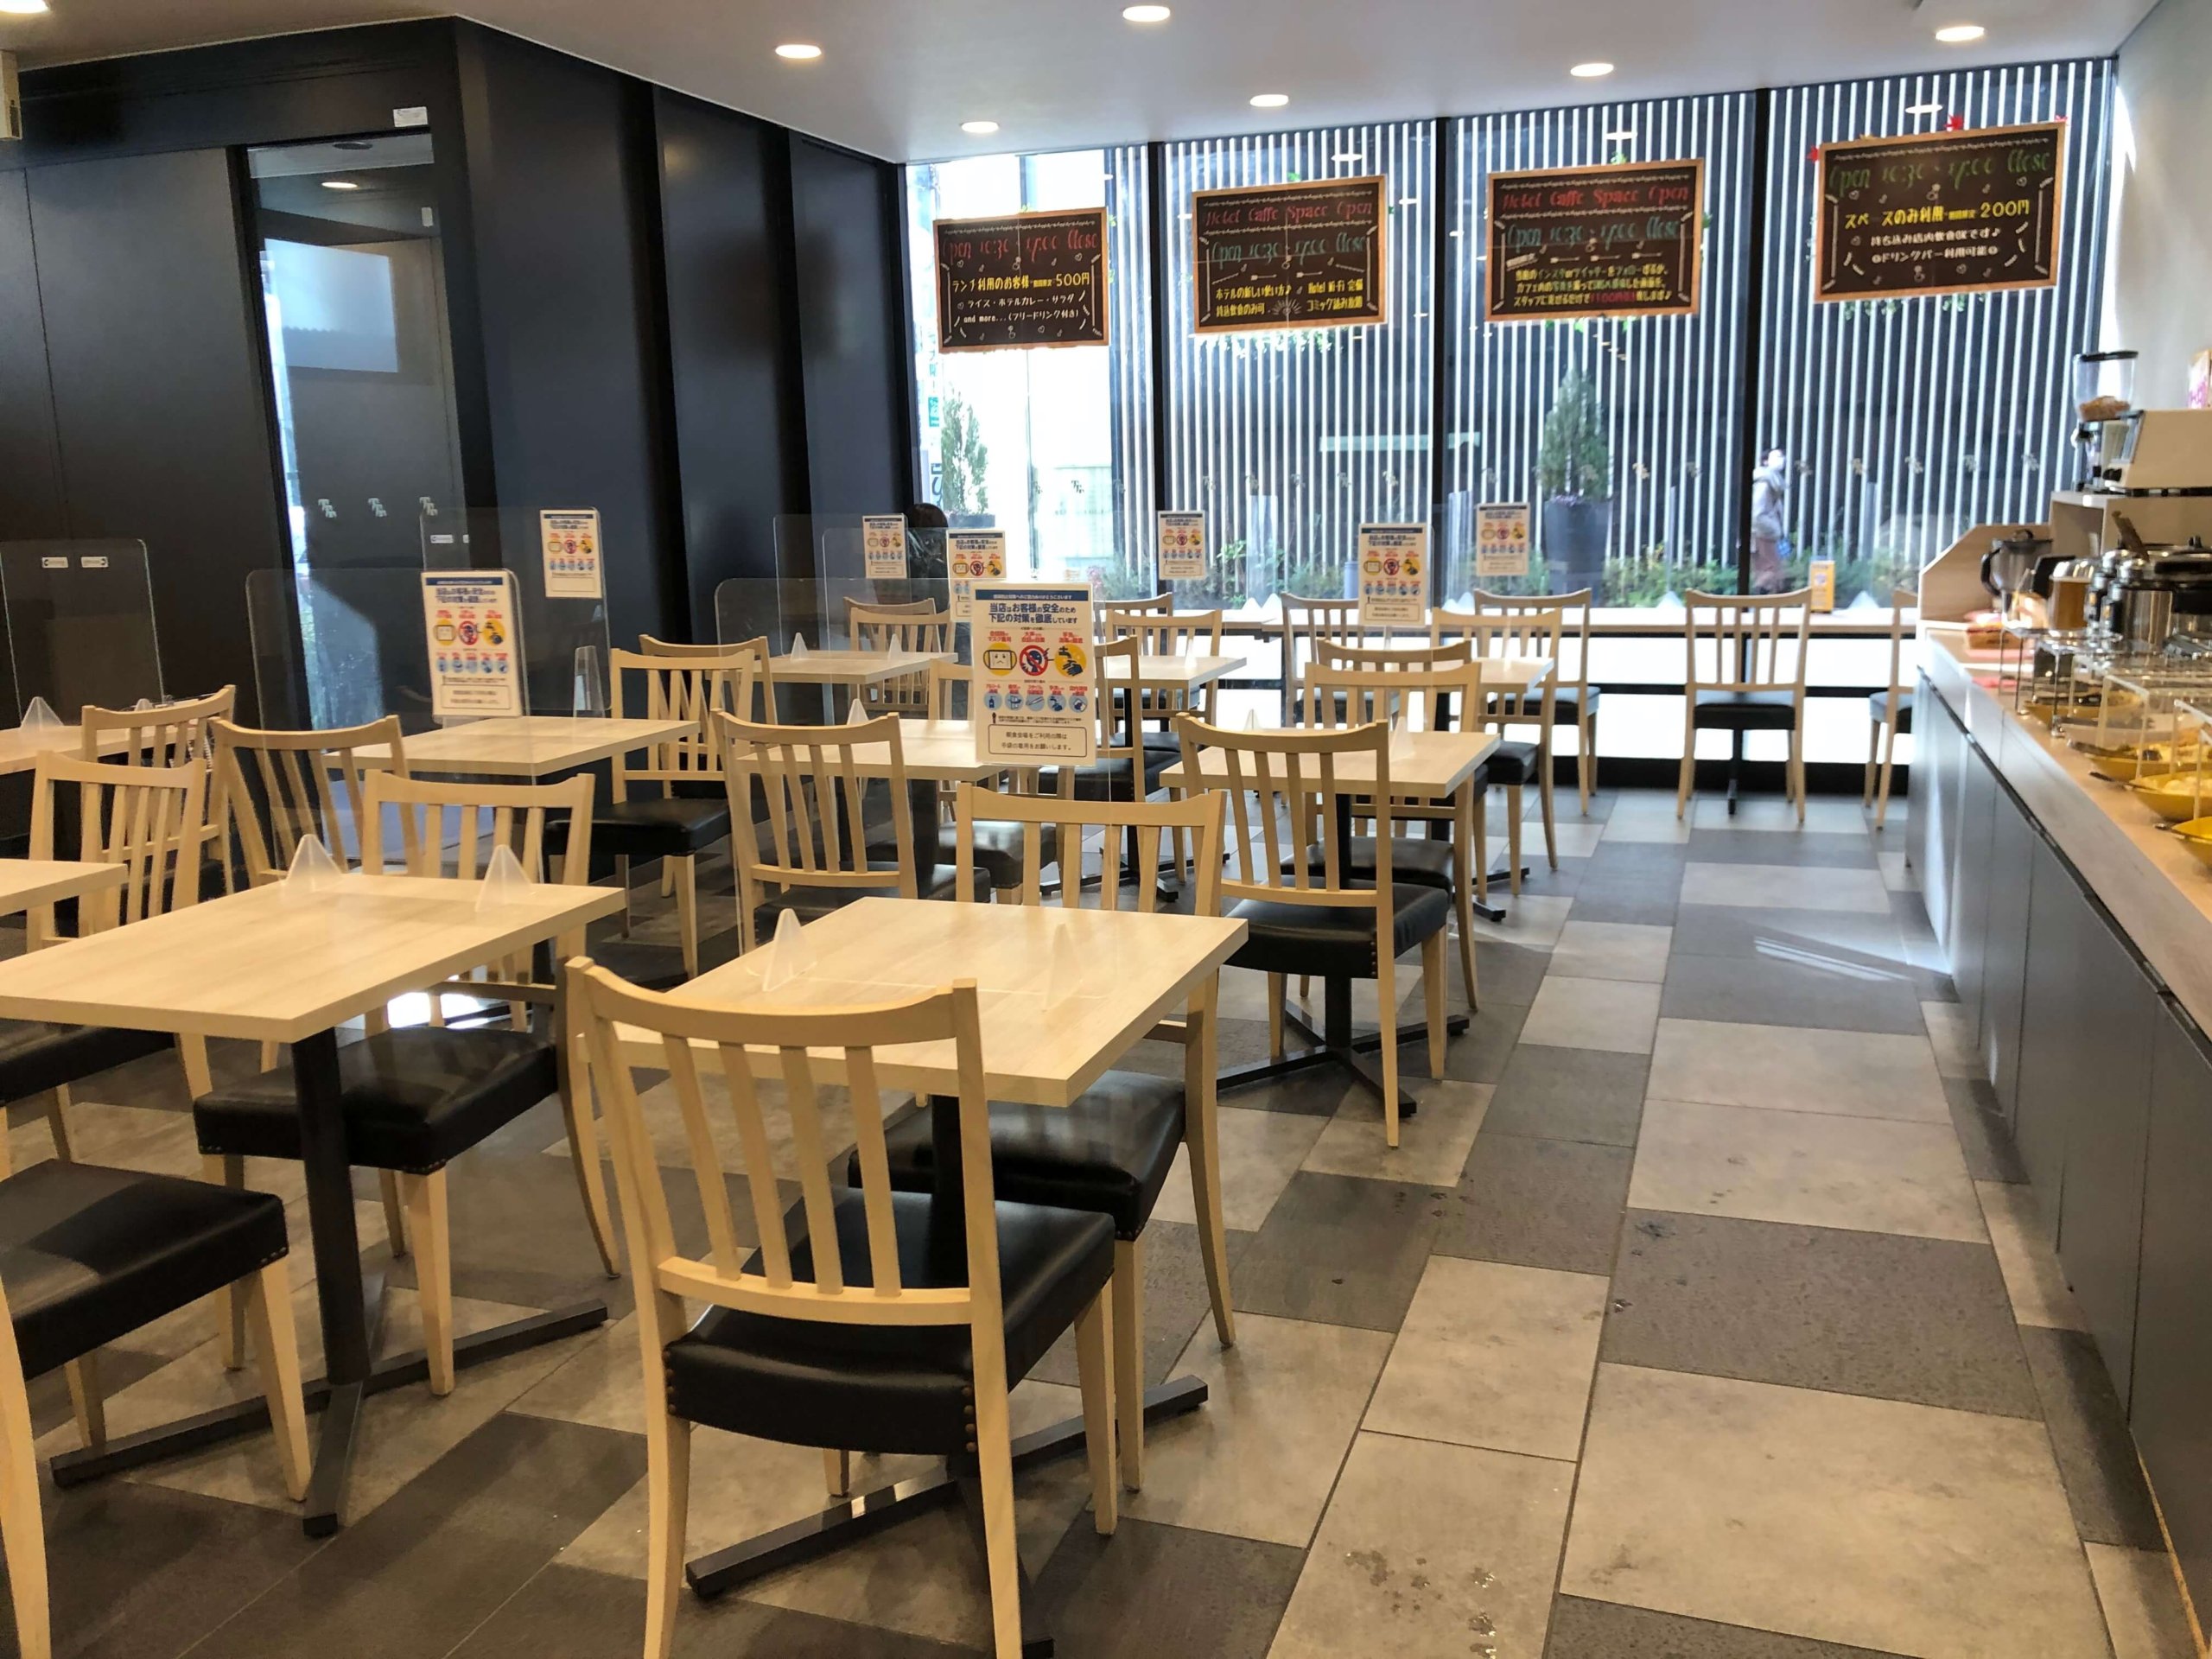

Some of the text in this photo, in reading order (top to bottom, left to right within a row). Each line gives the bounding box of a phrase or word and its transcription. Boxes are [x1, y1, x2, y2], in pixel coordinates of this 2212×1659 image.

[1844, 205, 1943, 230] スペスのみ利用
[1980, 199, 2031, 218] 200円
[1055, 271, 1090, 287] 500円
[963, 314, 976, 323] and
[989, 603, 1077, 614] 当店はお客様の安全のため
[989, 613, 1077, 624] 下記の対策を徹底しています
